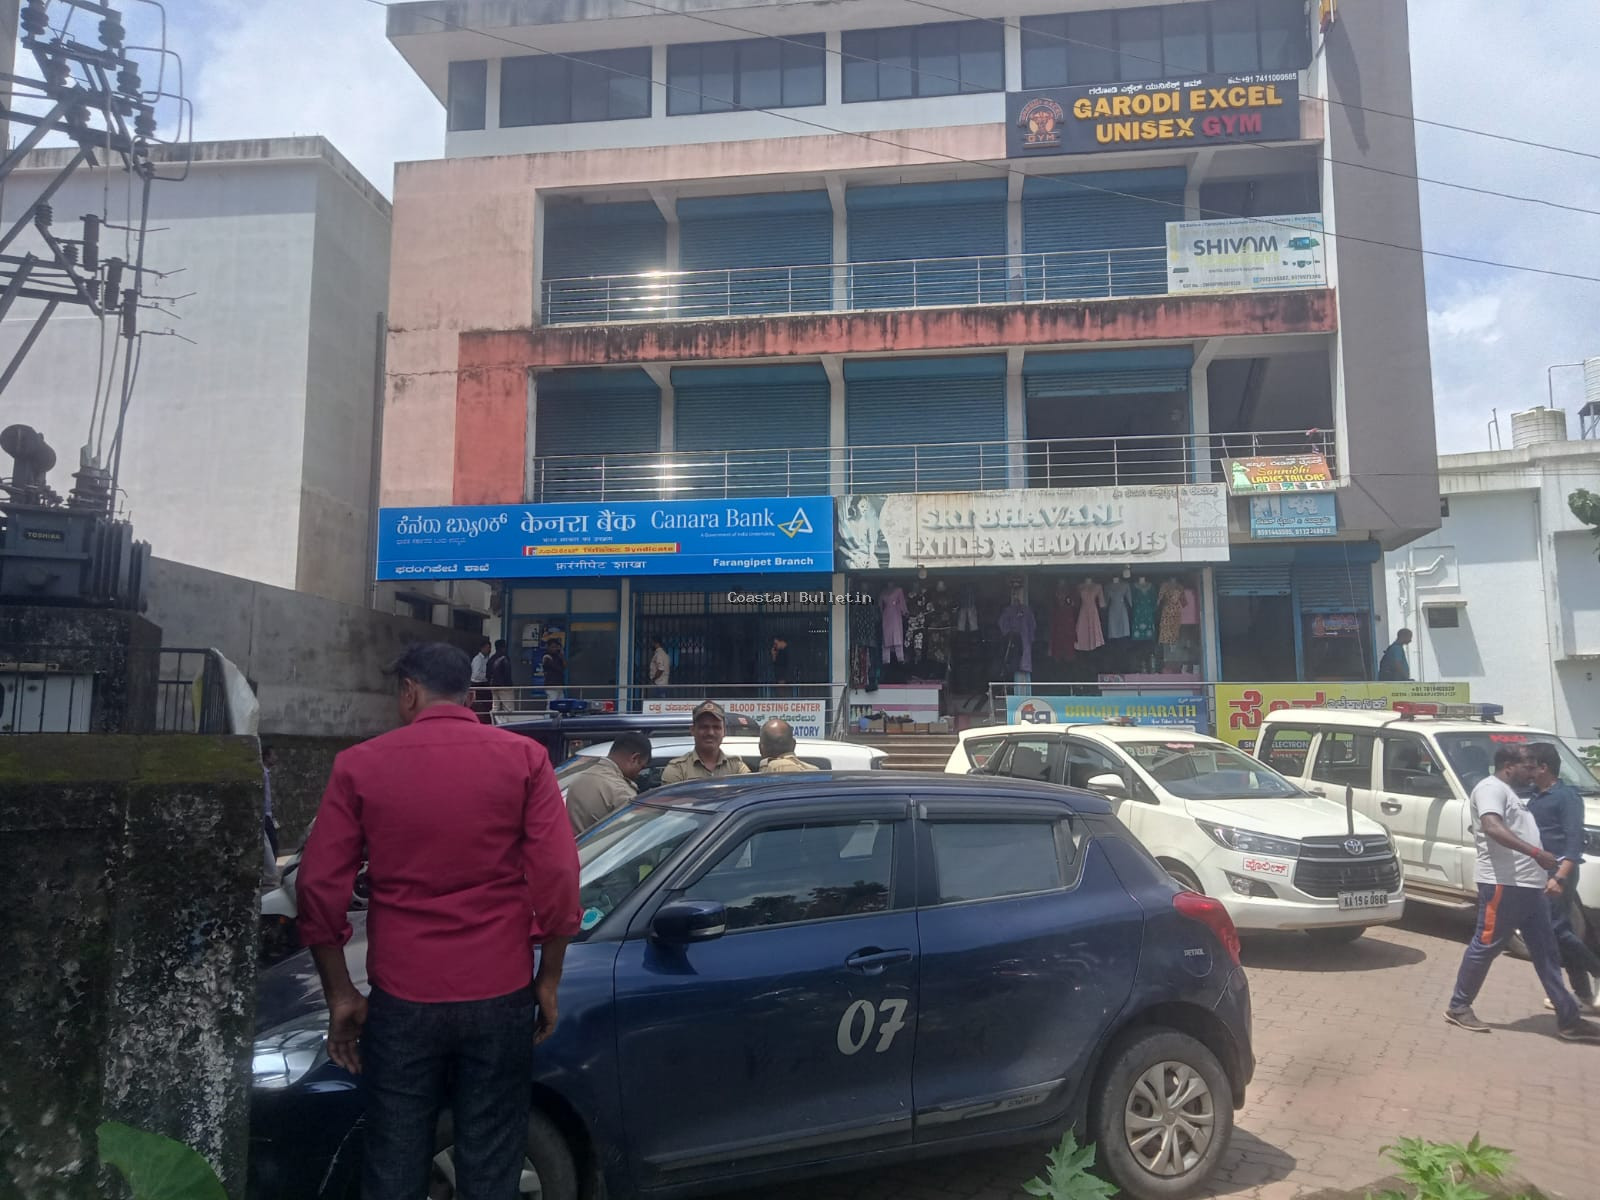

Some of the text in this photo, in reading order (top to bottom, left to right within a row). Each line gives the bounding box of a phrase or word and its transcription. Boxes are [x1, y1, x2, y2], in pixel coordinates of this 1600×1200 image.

[1073, 90, 1180, 119] GARODI
[1189, 84, 1283, 111] EXCEL
[1096, 113, 1263, 144] UNISEX GYM
[1251, 473, 1326, 484] LADIES TAILORS
[446, 513, 508, 538] ಬ್ಯಾಂಕ್
[520, 509, 637, 534] केनरा बैंक
[651, 508, 775, 530] Canara Bank
[979, 503, 1124, 529] BHAVANI
[624, 545, 674, 553] Syndicate
[899, 535, 996, 560] TEXTILES
[1020, 530, 1169, 558] READYMADES
[611, 561, 648, 569] शाखा
[713, 556, 814, 568] Farangipet Branch
[729, 703, 821, 712] BLOOD TESTING CENTER
[1065, 705, 1197, 718] BRIGHT BHARATH
[837, 998, 908, 1055] 07
